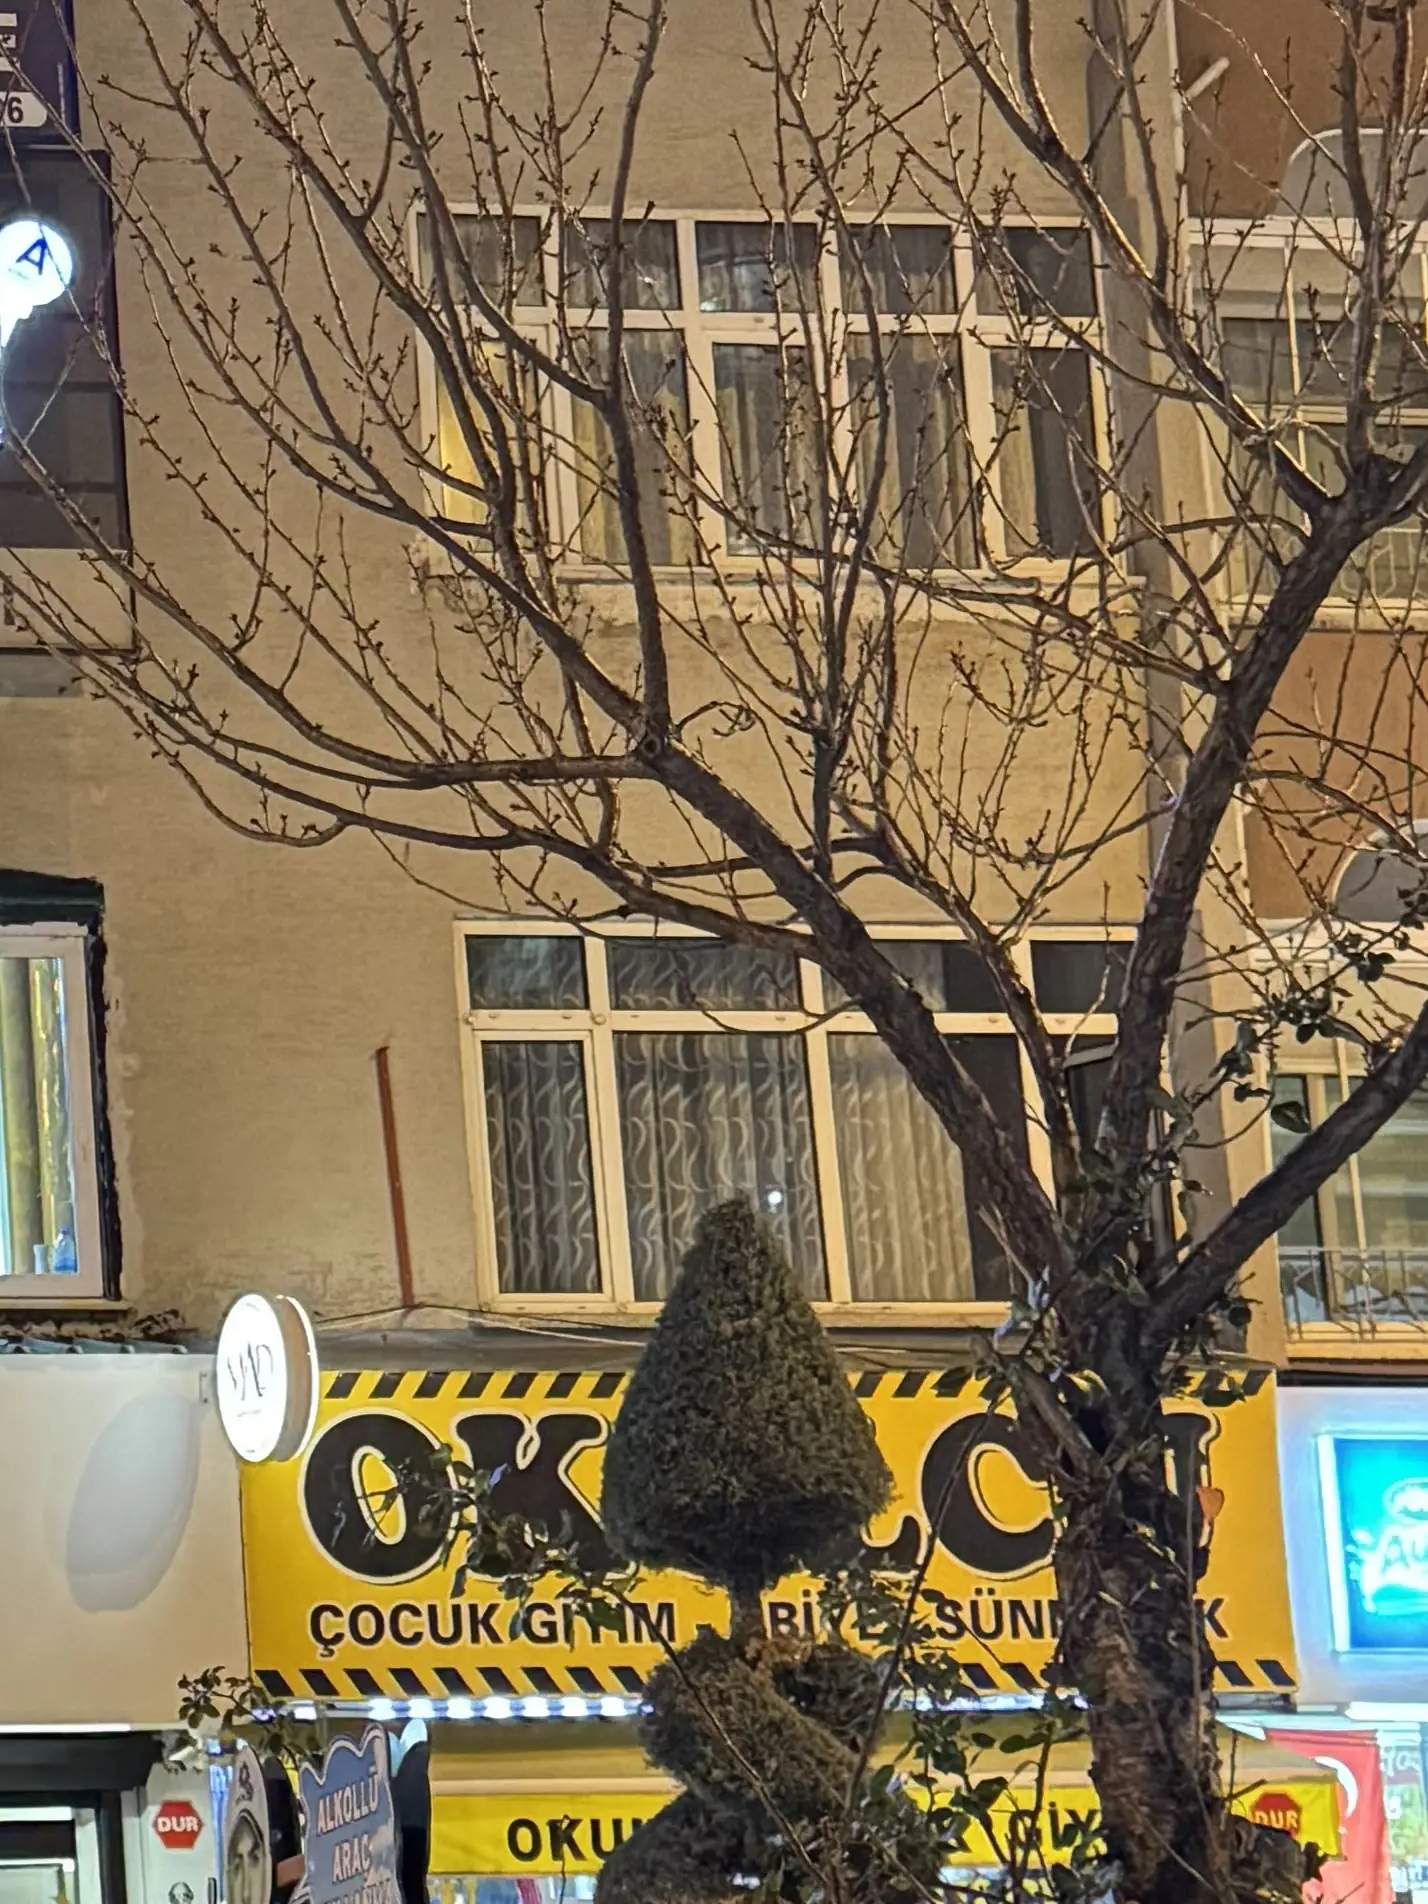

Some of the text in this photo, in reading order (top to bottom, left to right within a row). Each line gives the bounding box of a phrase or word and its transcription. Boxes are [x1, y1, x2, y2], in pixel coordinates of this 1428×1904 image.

[310, 1603, 504, 1658] ÇOCUK
[156, 1814, 200, 1834] DUR
[316, 1767, 380, 1837] ALKOLLÜ
[507, 1817, 646, 1863] OKU
